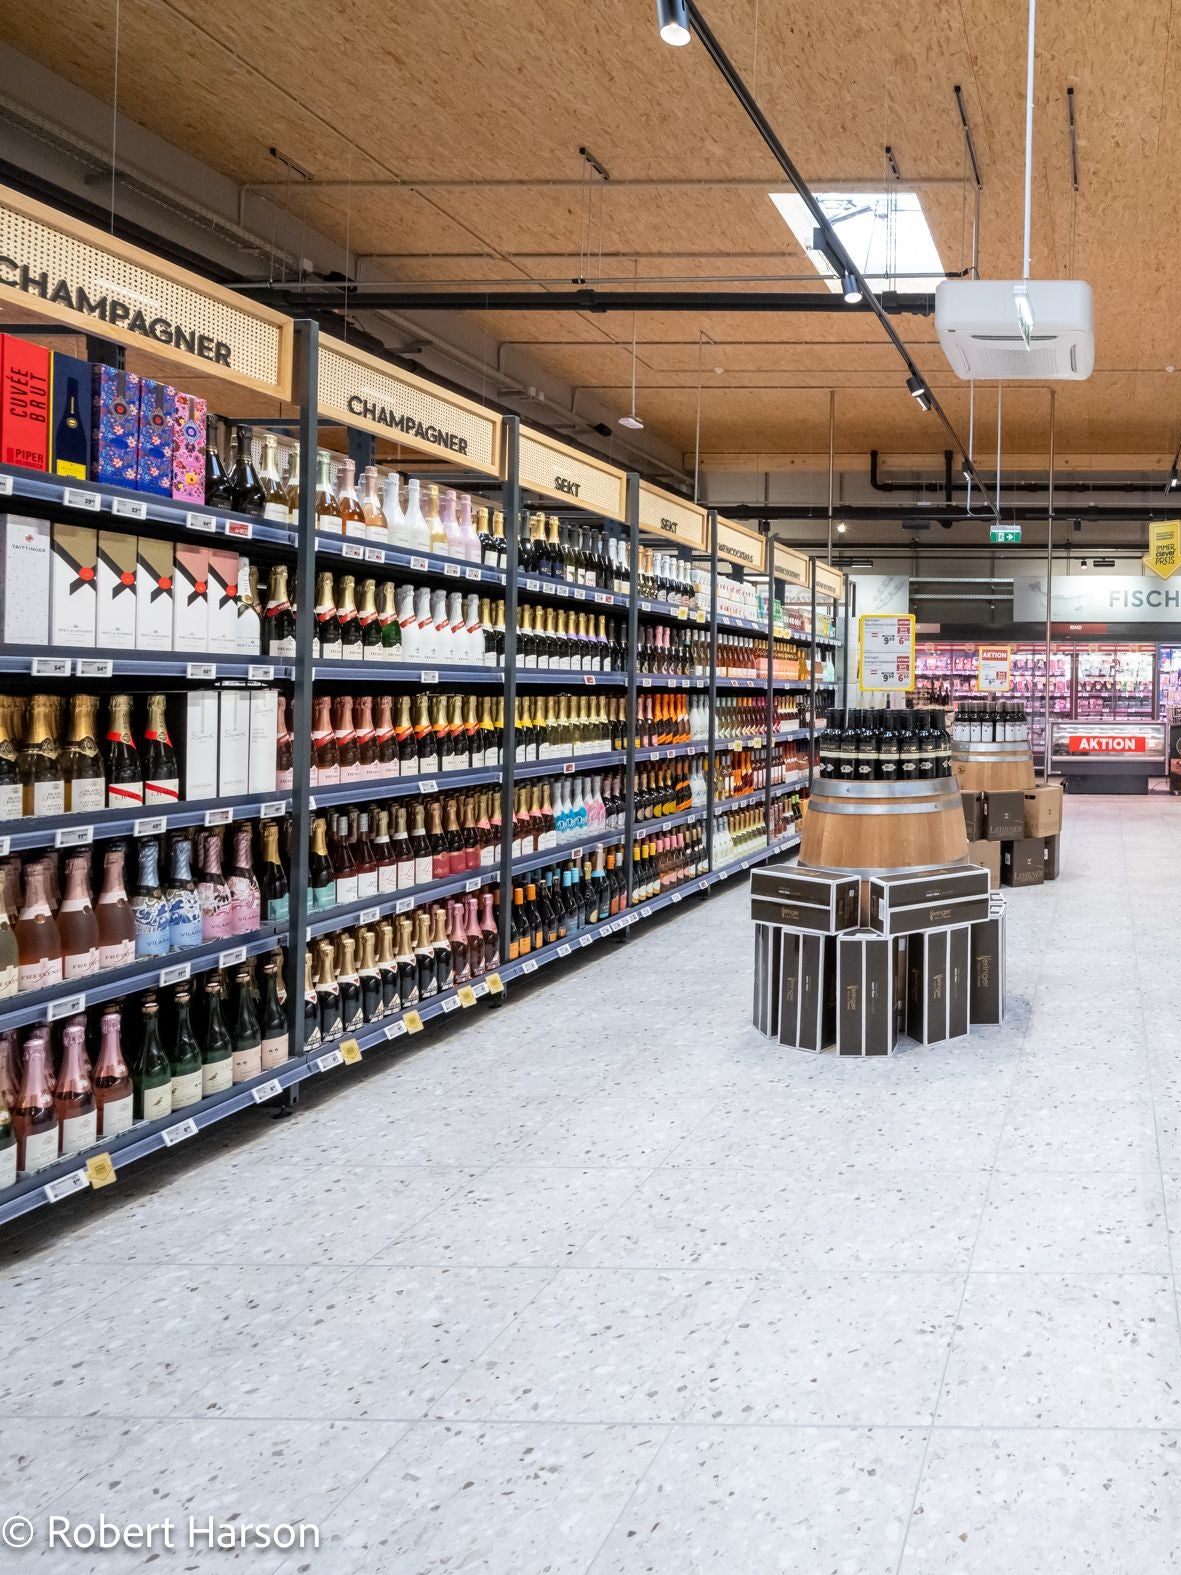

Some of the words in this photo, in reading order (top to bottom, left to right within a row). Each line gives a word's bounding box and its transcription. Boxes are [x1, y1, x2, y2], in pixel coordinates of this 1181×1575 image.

[0, 256, 232, 367] CHAMPAGNER
[6, 366, 29, 419] CUVÉE
[29, 372, 47, 423] BRUT
[347, 395, 469, 456] CHAMPAGNER
[15, 448, 44, 464] PIPER
[554, 476, 581, 498] SEKT
[660, 517, 678, 534] SEKT
[12, 543, 46, 553] TAITTINGER
[1155, 557, 1175, 566] PREIS
[1109, 590, 1180, 608] FISCH
[982, 651, 1007, 659] AKTION
[1079, 738, 1136, 750] AKTION
